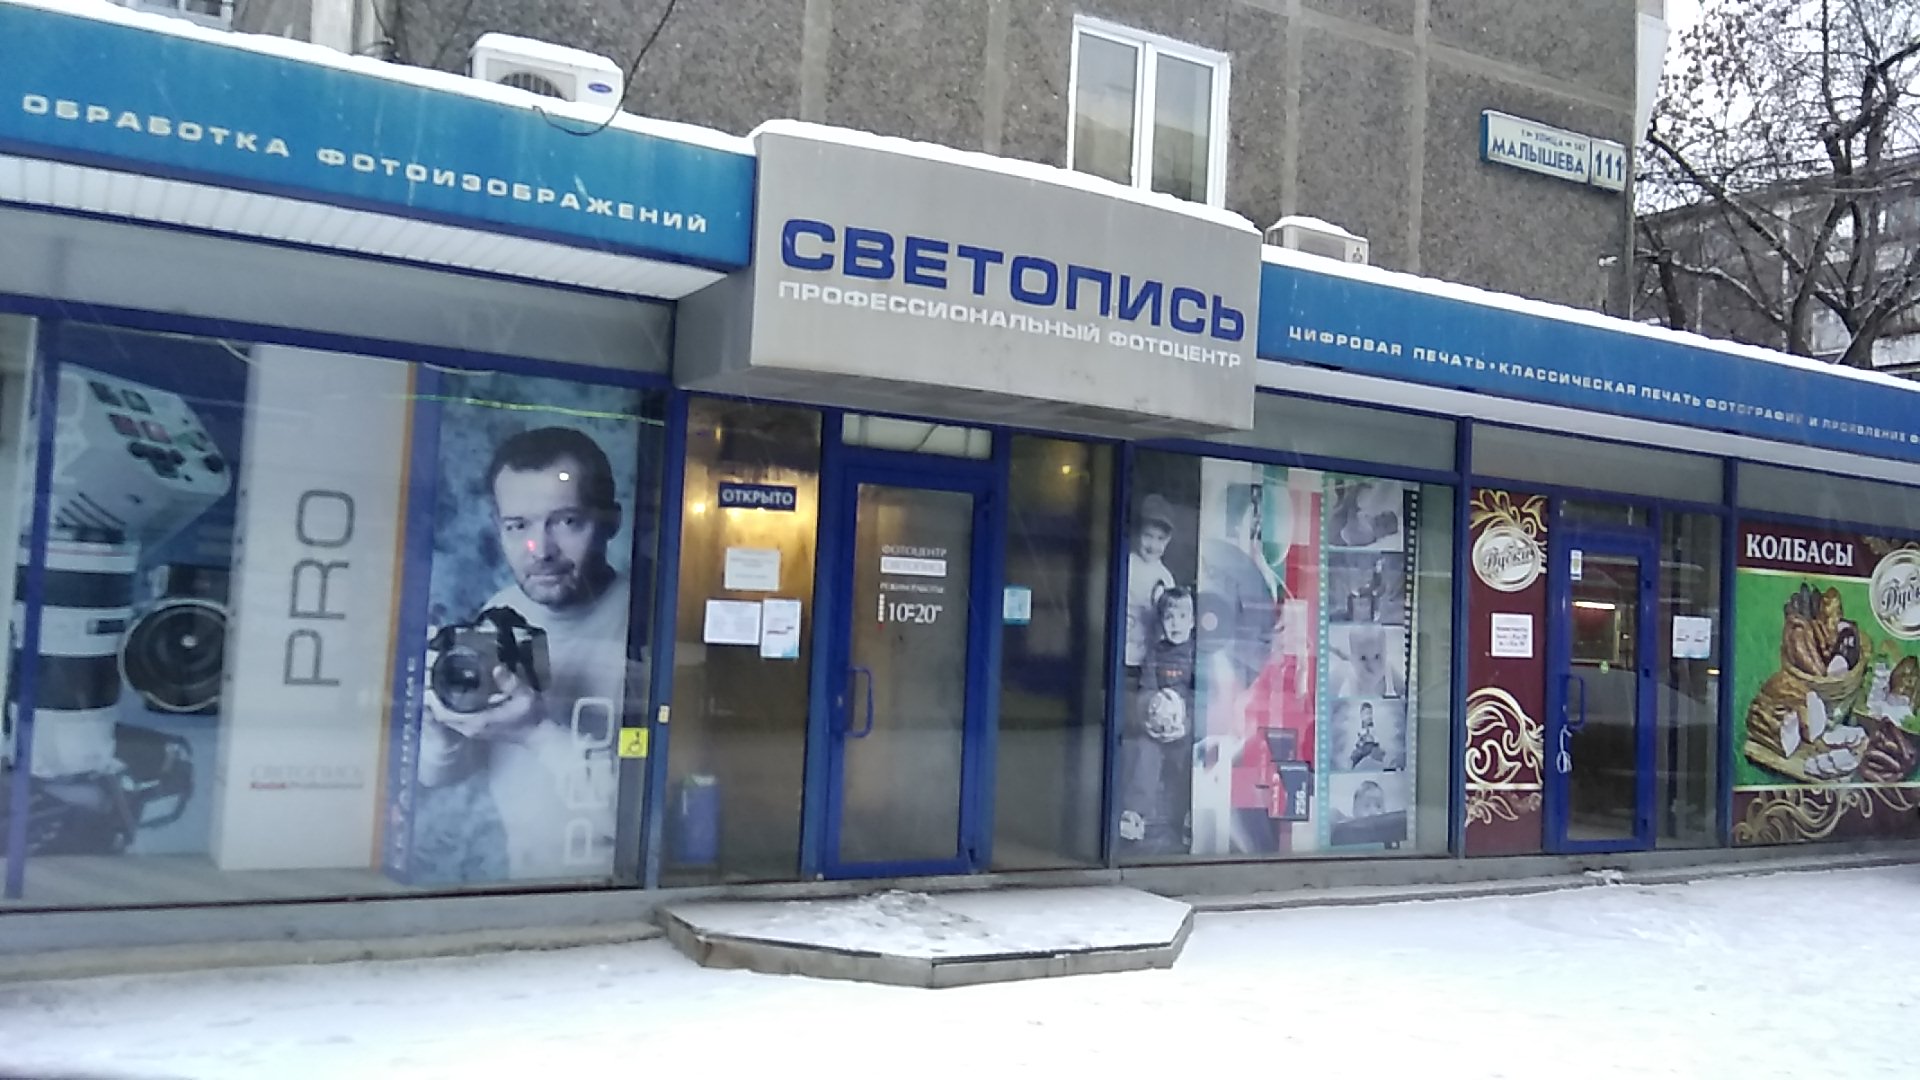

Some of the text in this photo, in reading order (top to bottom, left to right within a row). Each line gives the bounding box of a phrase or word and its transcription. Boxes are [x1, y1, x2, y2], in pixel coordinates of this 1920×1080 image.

[22, 94, 709, 234] ОБРАБОТКА ФОТОИЗОБРАЖЕНИЙ
[1492, 136, 1584, 175] МАЛЫШЕВА
[1595, 150, 1622, 182] 111
[780, 218, 1246, 342] СВЕТОПИСЬ
[778, 281, 1242, 368] ПРОФЕССИОНАЛЬНЫЙ ФОТОЦЕНТР
[1289, 325, 1402, 356] ЦИФРОВАЯ
[1413, 346, 1485, 371] ПЕЧАТЬ
[1499, 362, 1636, 396] КЛАССИЧЕСКАЯ
[1641, 386, 1701, 408] ПЕЧАТЬ
[1809, 416, 1818, 428] И
[721, 488, 794, 505] ОТКРЫТО
[881, 544, 947, 557] ФОТОЦЕНТР
[1746, 533, 1853, 567] КОЛБАСЫ
[284, 489, 355, 686] PRO
